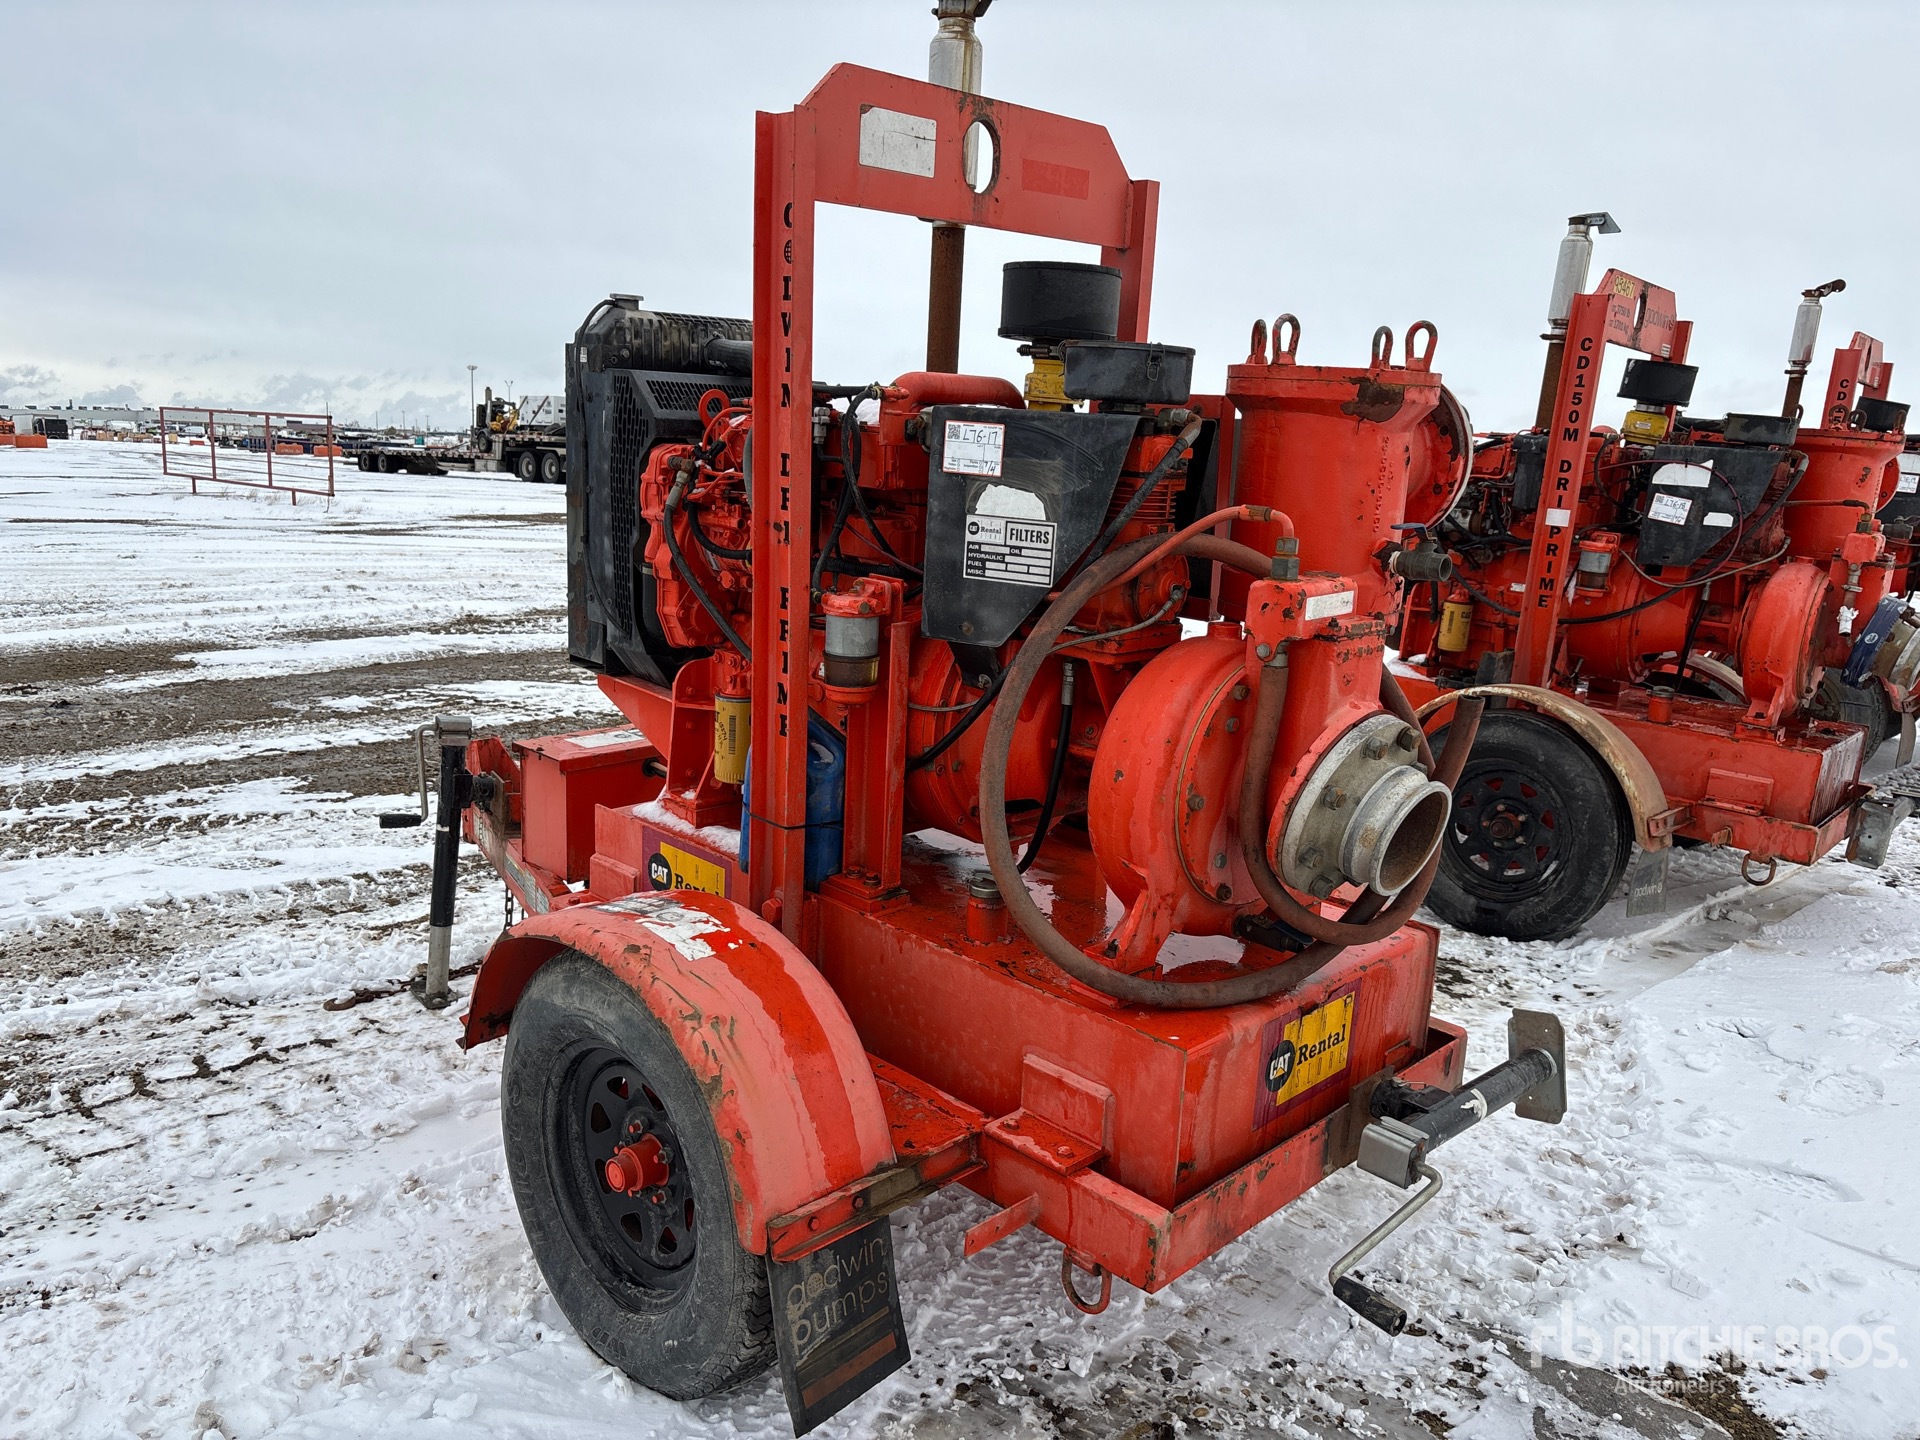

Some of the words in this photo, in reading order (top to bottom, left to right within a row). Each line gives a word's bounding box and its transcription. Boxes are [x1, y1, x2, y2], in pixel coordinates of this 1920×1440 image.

[1562, 337, 1594, 443] CD150M
[962, 428, 998, 445] L76-17
[1556, 459, 1572, 508] DRI
[980, 526, 1002, 535] Rental
[1009, 528, 1050, 544] FILTERS
[968, 552, 1004, 561] HYDRAULIC
[1537, 526, 1562, 608] PRIME
[651, 862, 668, 885] CAT
[1269, 1051, 1291, 1081] CAT
[1296, 1023, 1347, 1067] Rental
[792, 1270, 889, 1355] pumps
